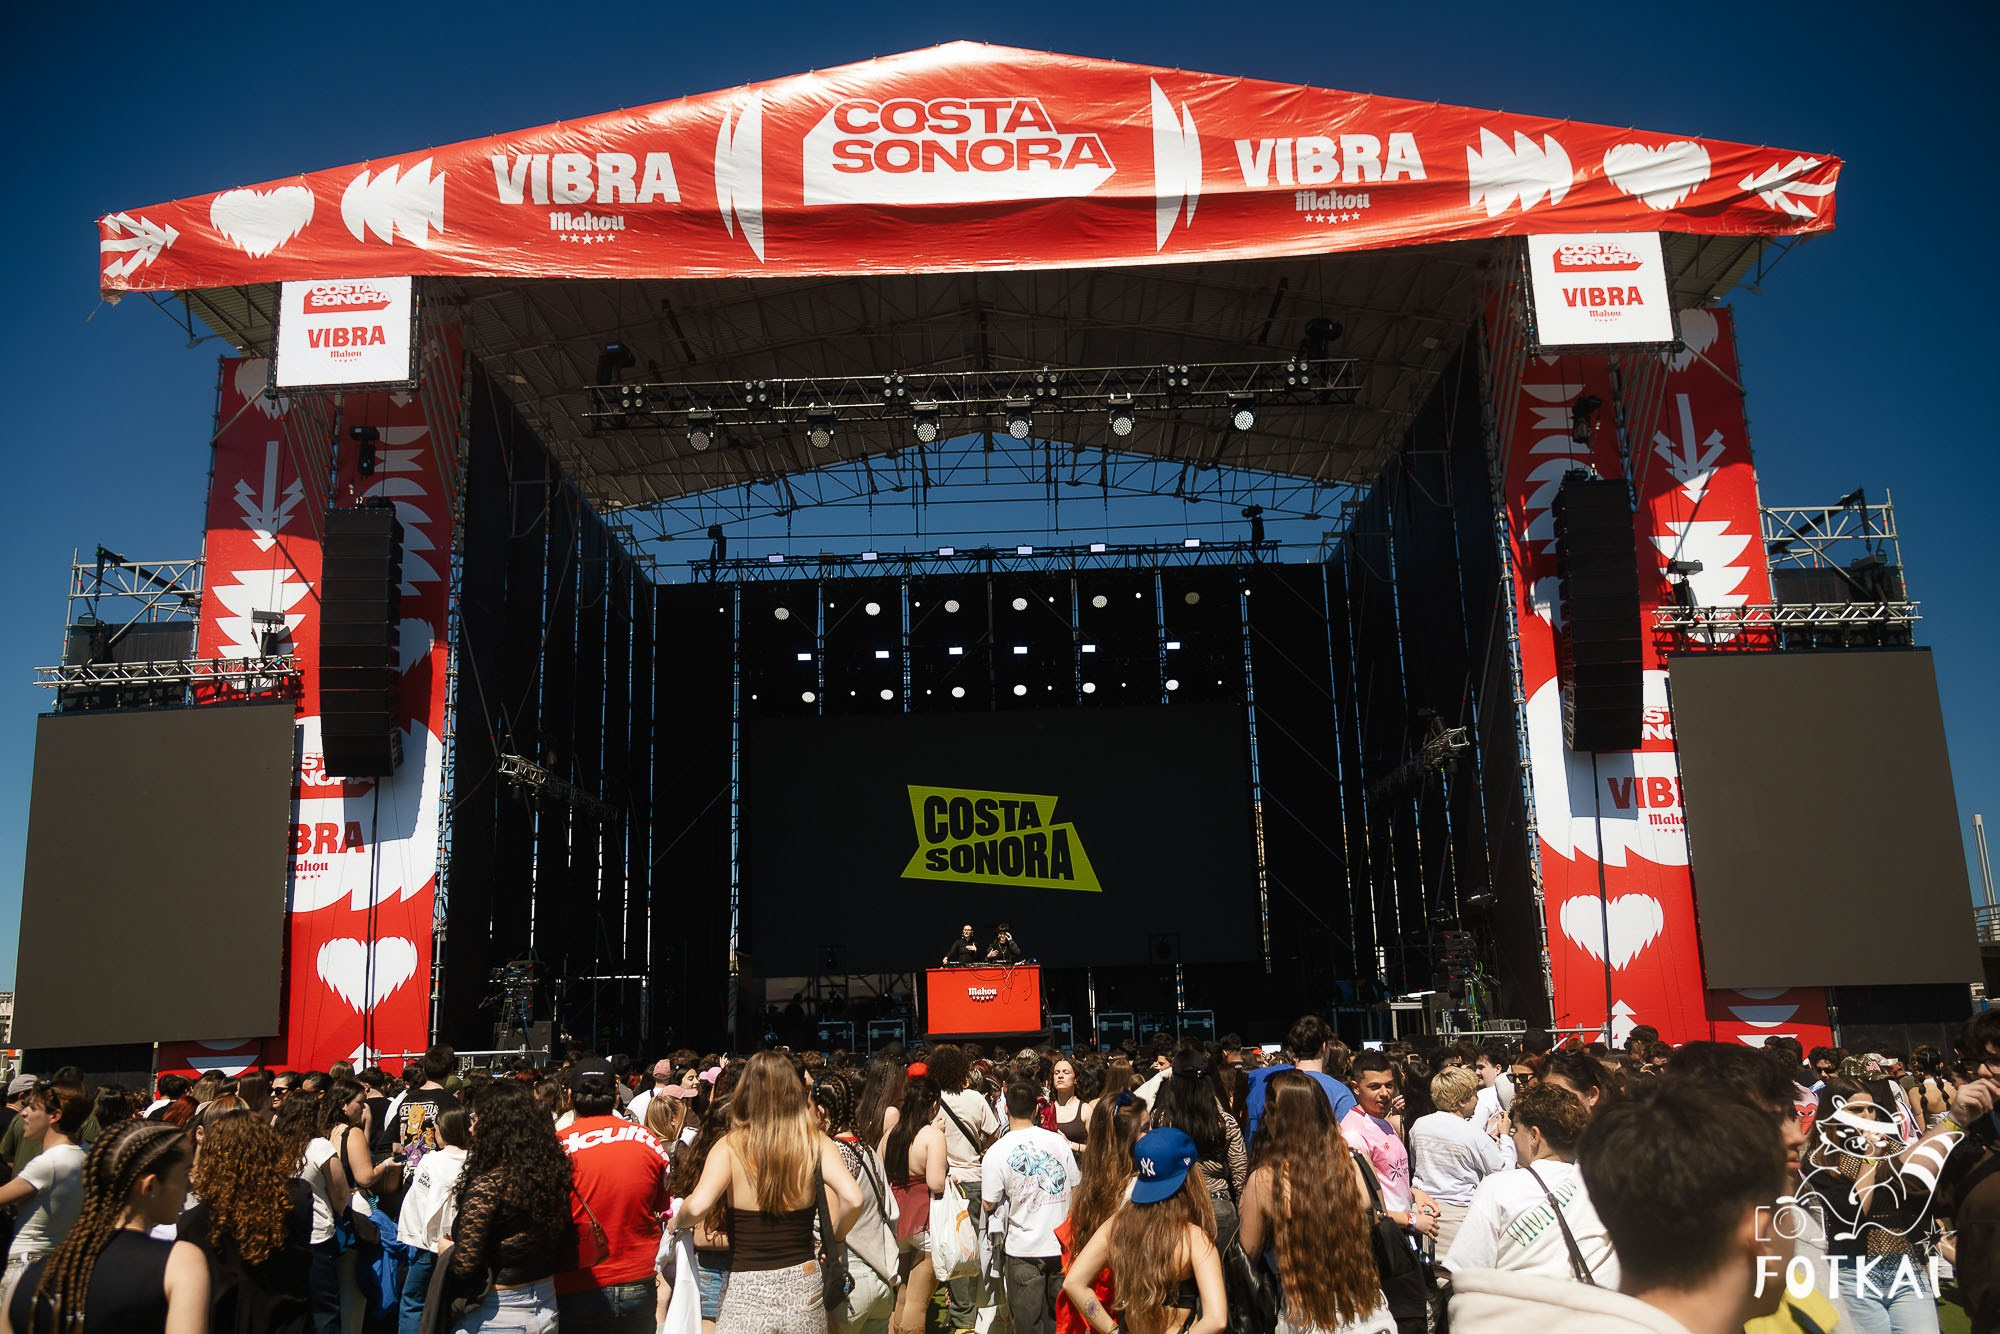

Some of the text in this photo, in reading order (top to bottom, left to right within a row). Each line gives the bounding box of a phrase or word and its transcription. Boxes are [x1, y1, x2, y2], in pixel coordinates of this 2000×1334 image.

[833, 100, 1053, 134] COSTA
[832, 136, 1112, 173] SONORA
[1234, 132, 1428, 187] VIBRA
[491, 152, 682, 205] VIBRA
[1294, 189, 1370, 211] Mahou
[549, 211, 626, 231] Mahou
[1560, 243, 1627, 255] COSTA
[1560, 253, 1644, 266] SONORA
[310, 291, 393, 307] SONORA
[311, 282, 377, 295] COSTA
[1562, 286, 1644, 307] VIBRA
[1589, 309, 1621, 317] Mahou
[307, 325, 386, 348] VIBRA
[330, 350, 362, 358] Mahou
[1606, 776, 1685, 810] VIB
[923, 795, 1042, 844] COSTA
[1648, 813, 1687, 826] Maho
[289, 821, 365, 855] BRA
[925, 828, 1075, 880] SONORA
[968, 987, 997, 996] Mahou
[1140, 1157, 1156, 1177] NY
